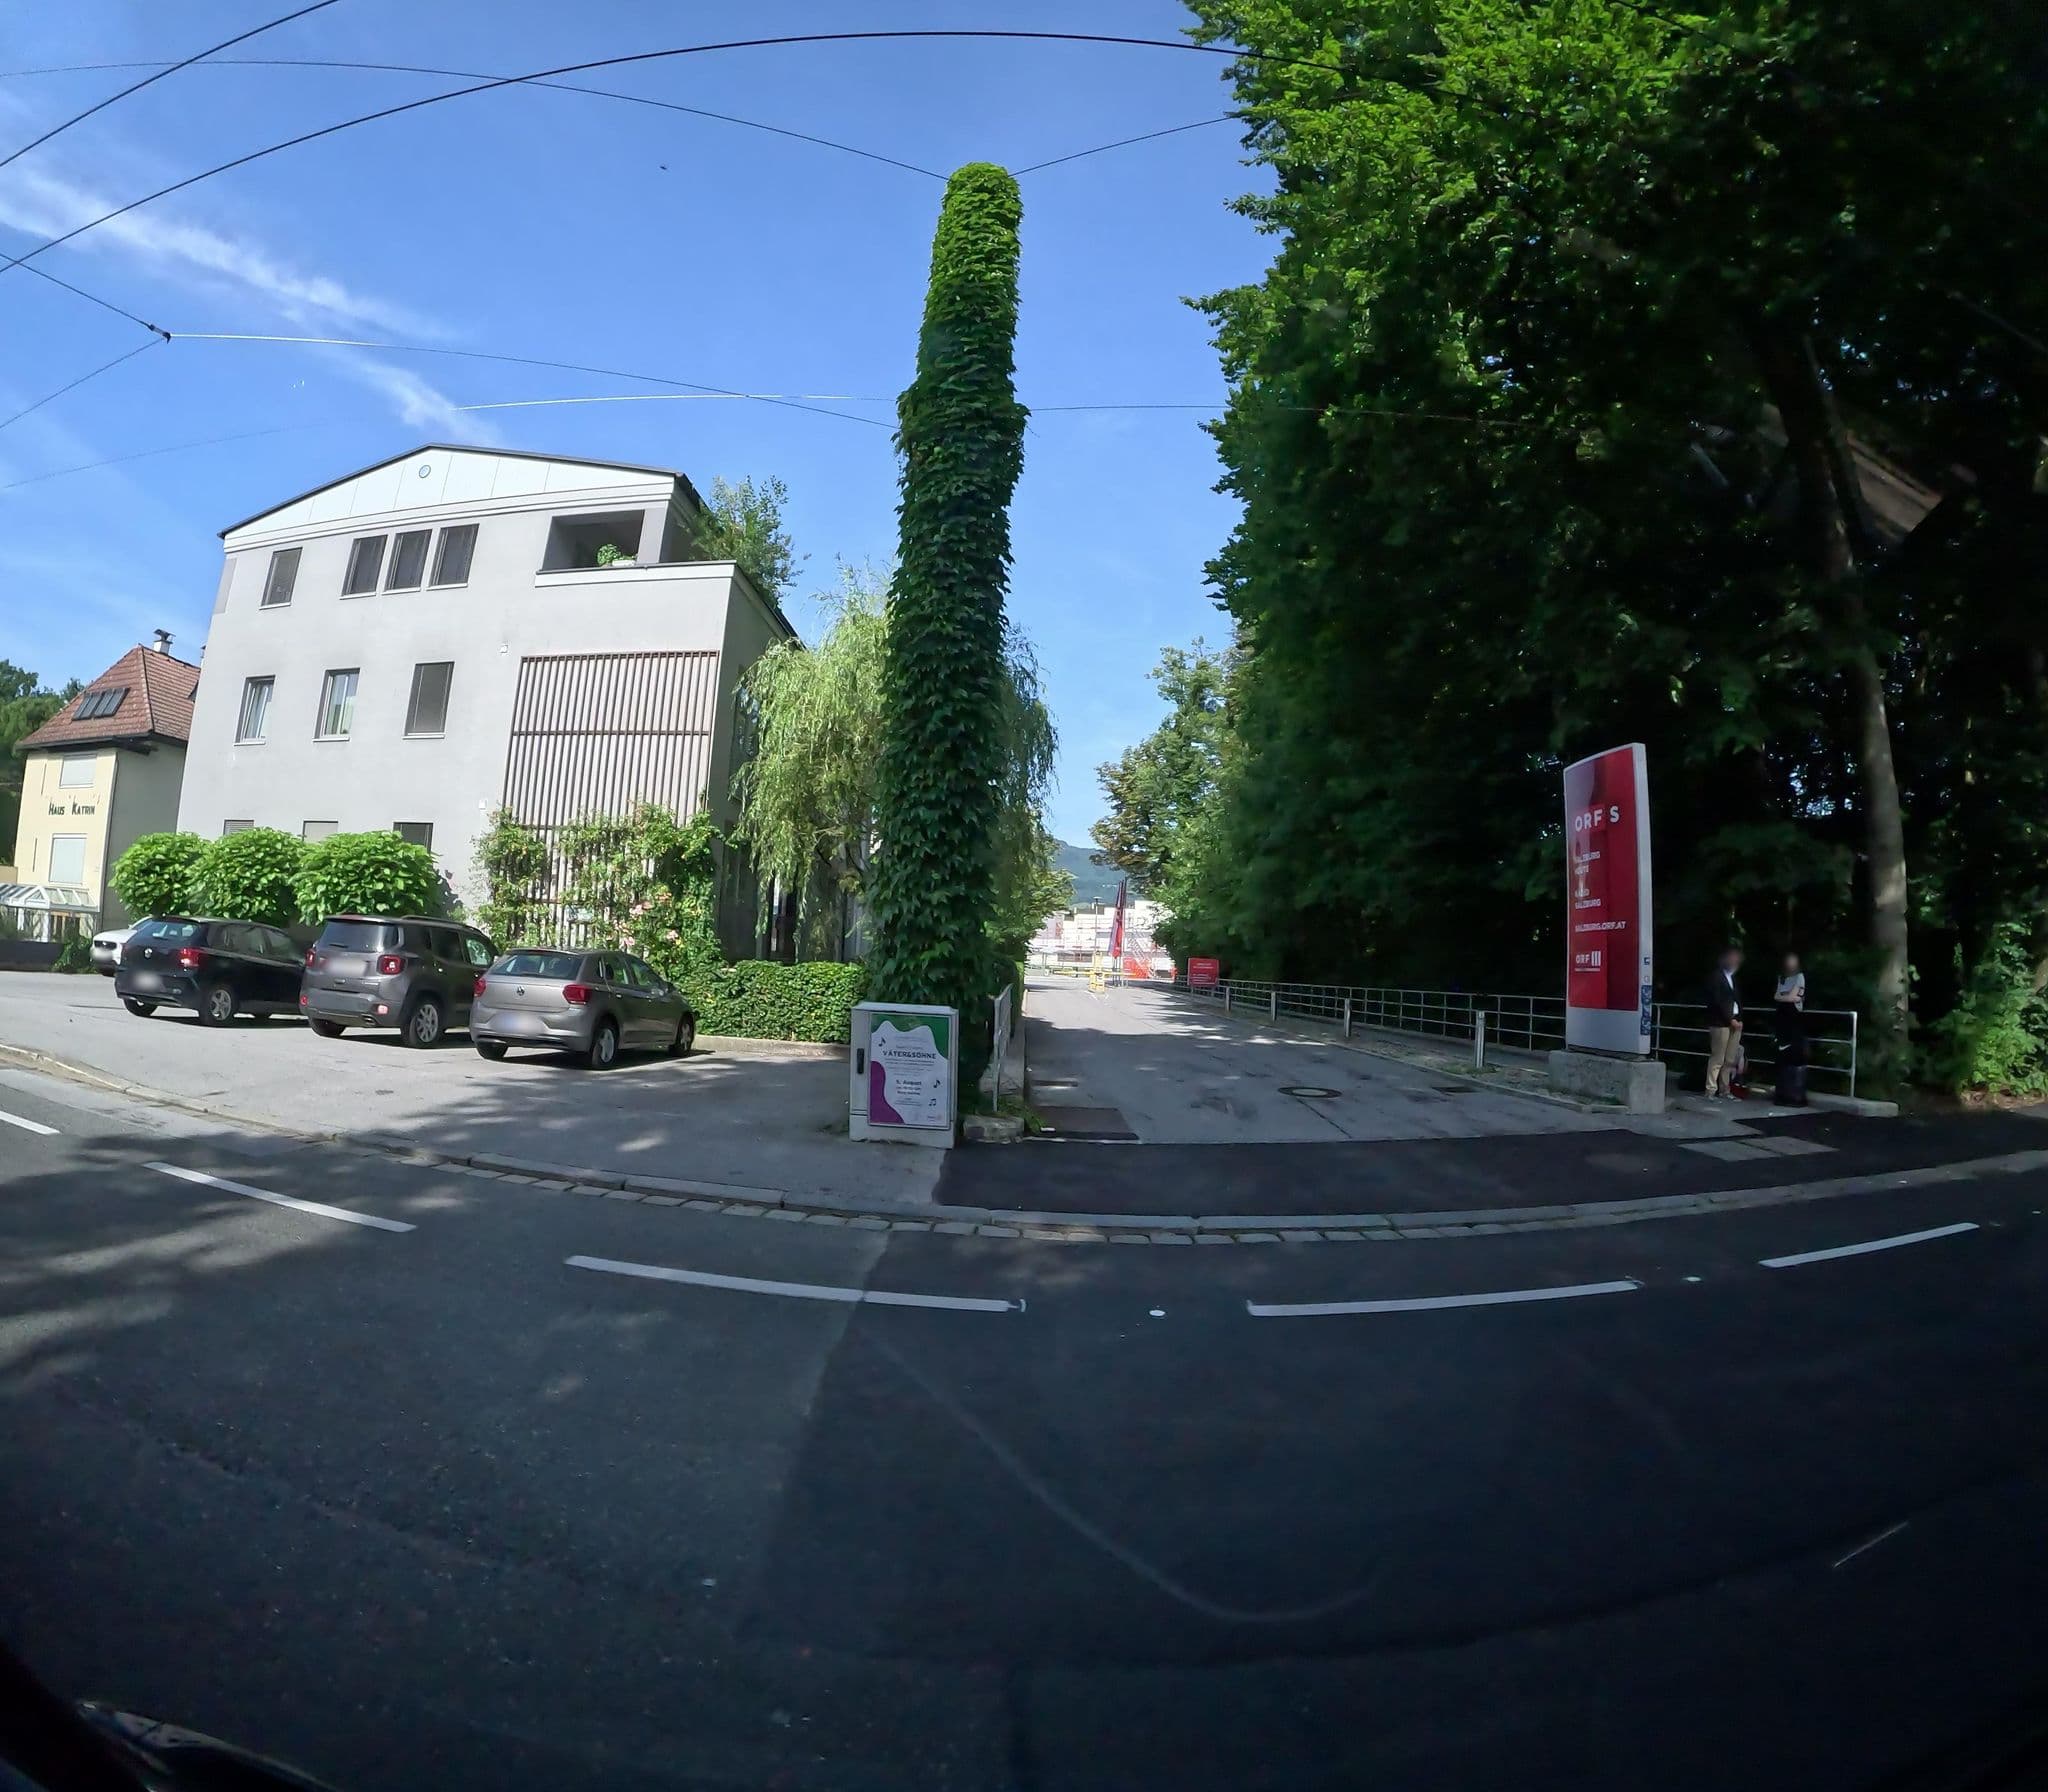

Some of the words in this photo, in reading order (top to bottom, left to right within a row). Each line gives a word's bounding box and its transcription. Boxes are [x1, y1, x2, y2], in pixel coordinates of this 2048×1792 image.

[48, 802, 65, 815] HAUS
[1575, 809, 1603, 832] ORF
[1609, 805, 1620, 823] S
[1575, 953, 1590, 964] ORF
